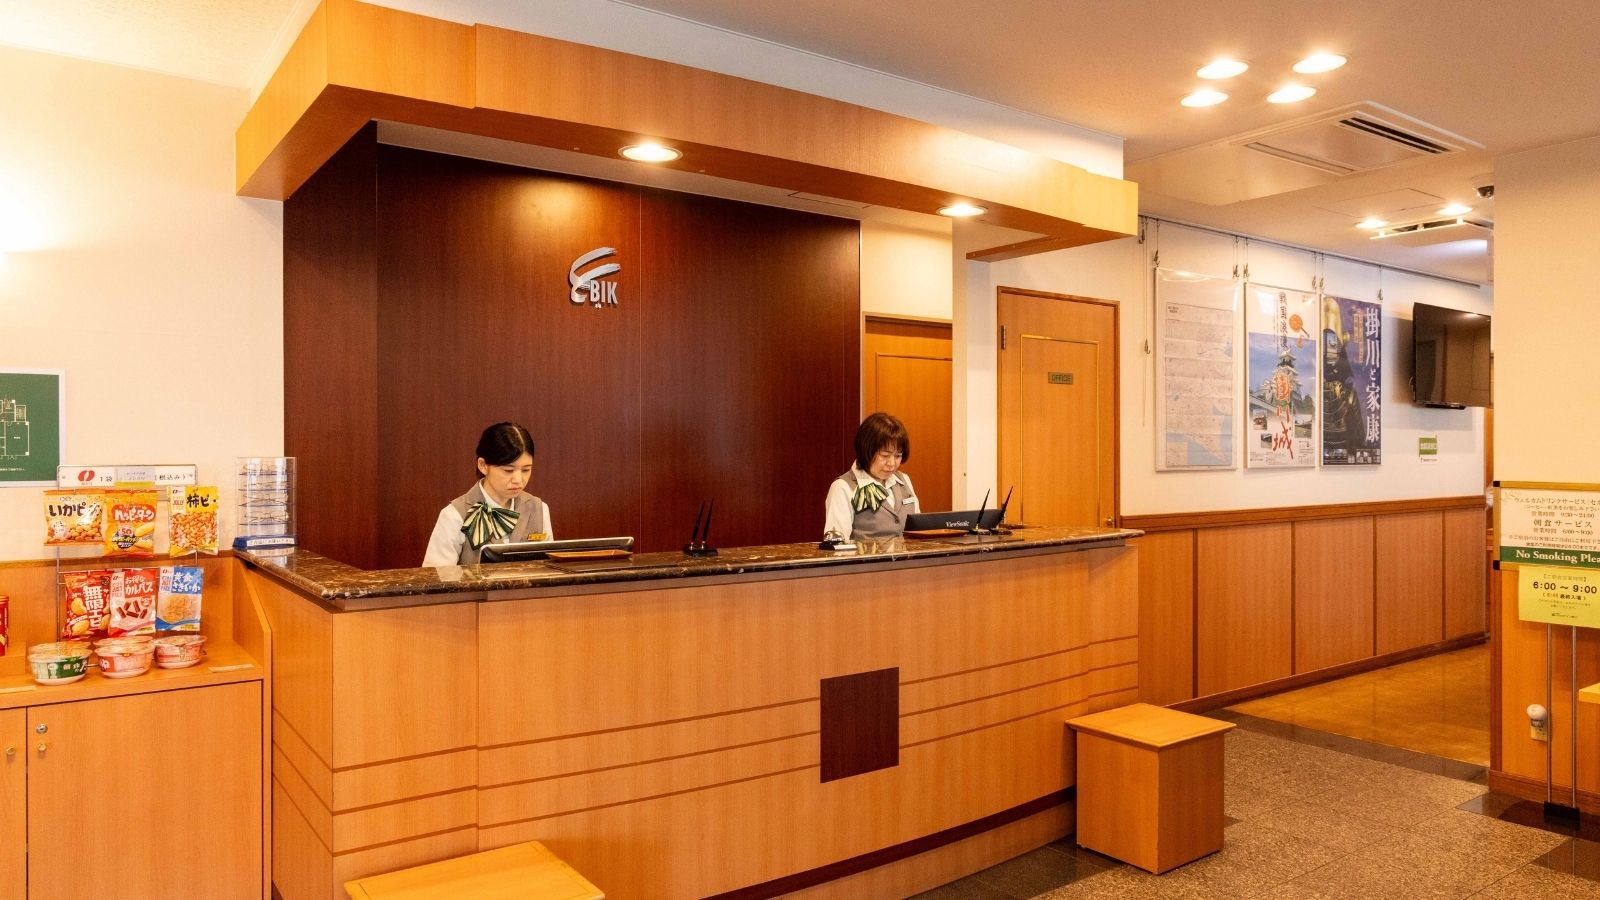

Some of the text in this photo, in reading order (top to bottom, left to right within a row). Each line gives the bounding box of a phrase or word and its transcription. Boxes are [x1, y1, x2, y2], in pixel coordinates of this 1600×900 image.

[1365, 307, 1381, 443] 掛川と家康
[1533, 519, 1592, 528] 朝食サービス
[1516, 549, 1531, 559] No
[1533, 551, 1578, 564] Smoking
[1533, 581, 1556, 590] 6:00
[1572, 584, 1598, 594] 9:00
